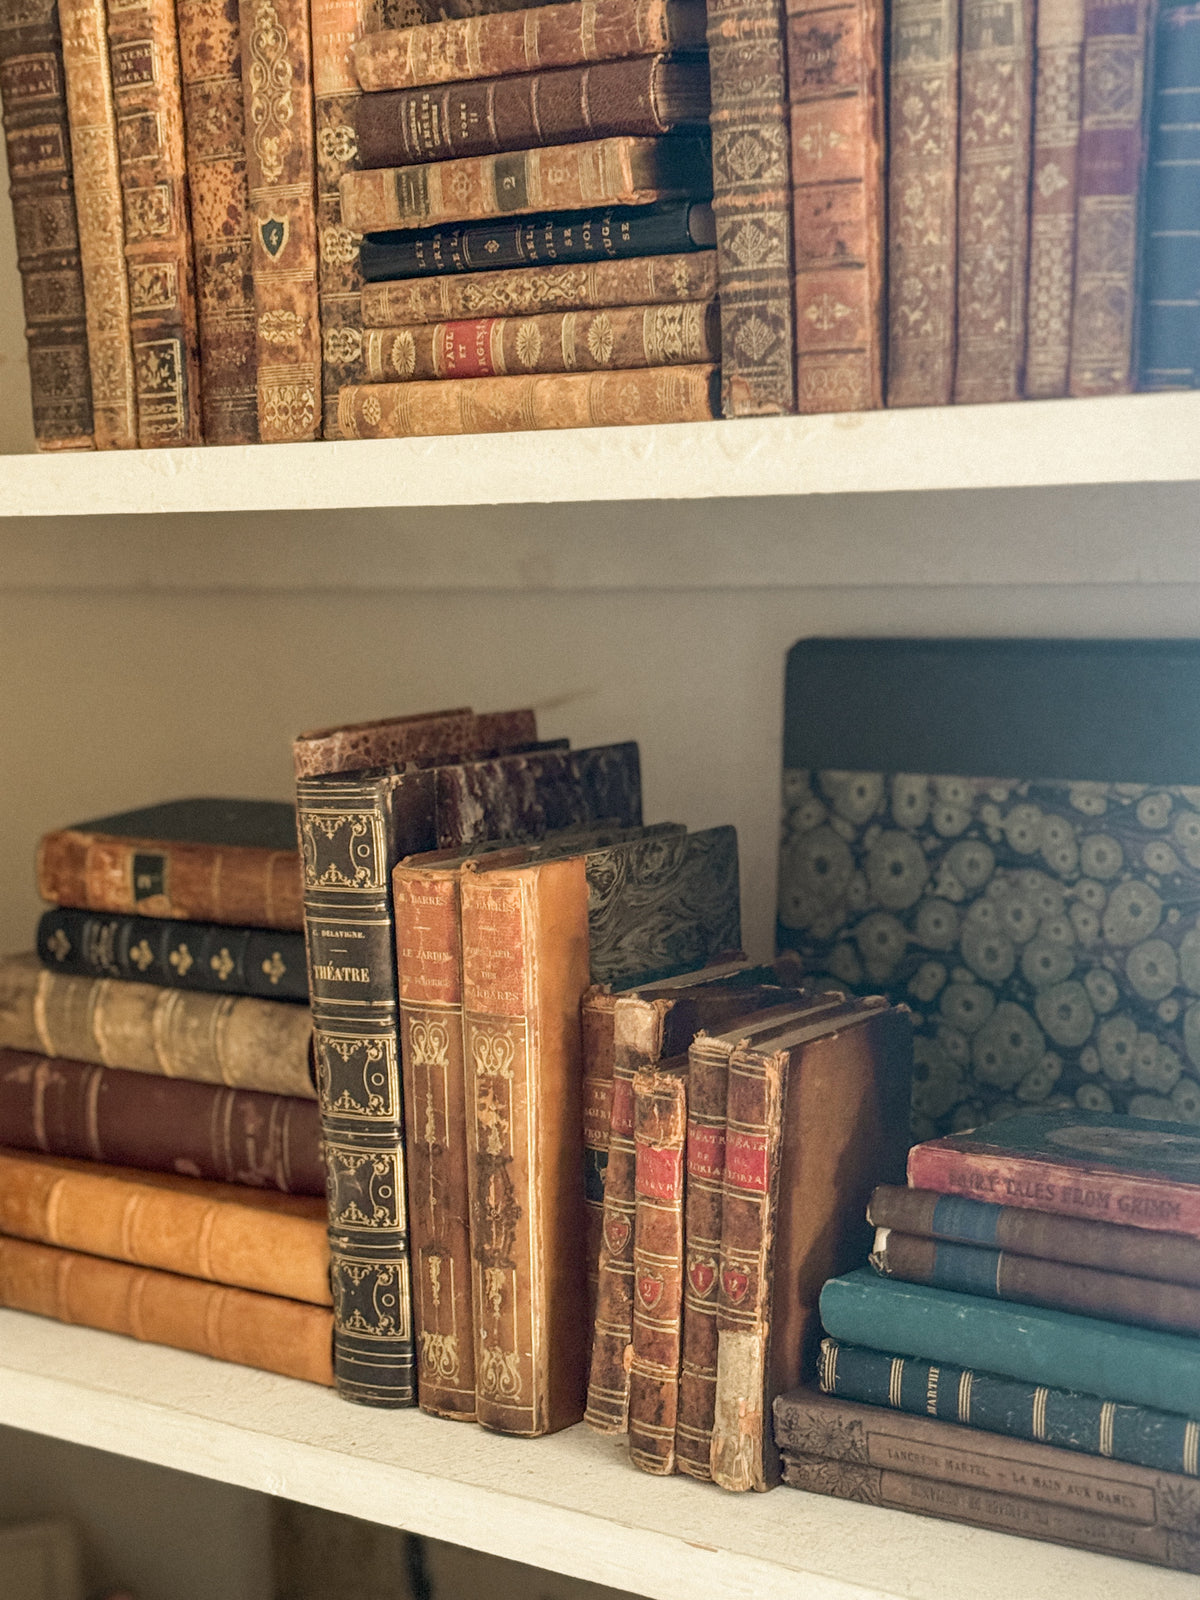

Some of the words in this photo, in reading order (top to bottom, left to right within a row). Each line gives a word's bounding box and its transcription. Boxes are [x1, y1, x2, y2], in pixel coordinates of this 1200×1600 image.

[460, 103, 469, 138] TOME
[503, 176, 516, 191] 2
[563, 228, 573, 247] SE
[620, 222, 631, 242] SE
[445, 331, 456, 369] PAUL
[458, 344, 467, 359] ET
[402, 948, 412, 958] LE
[312, 960, 370, 983] THÉATRE
[1006, 1177, 1055, 1199] TALES
[643, 1282, 653, 1298] 2
[1012, 1472, 1026, 1485] LA
